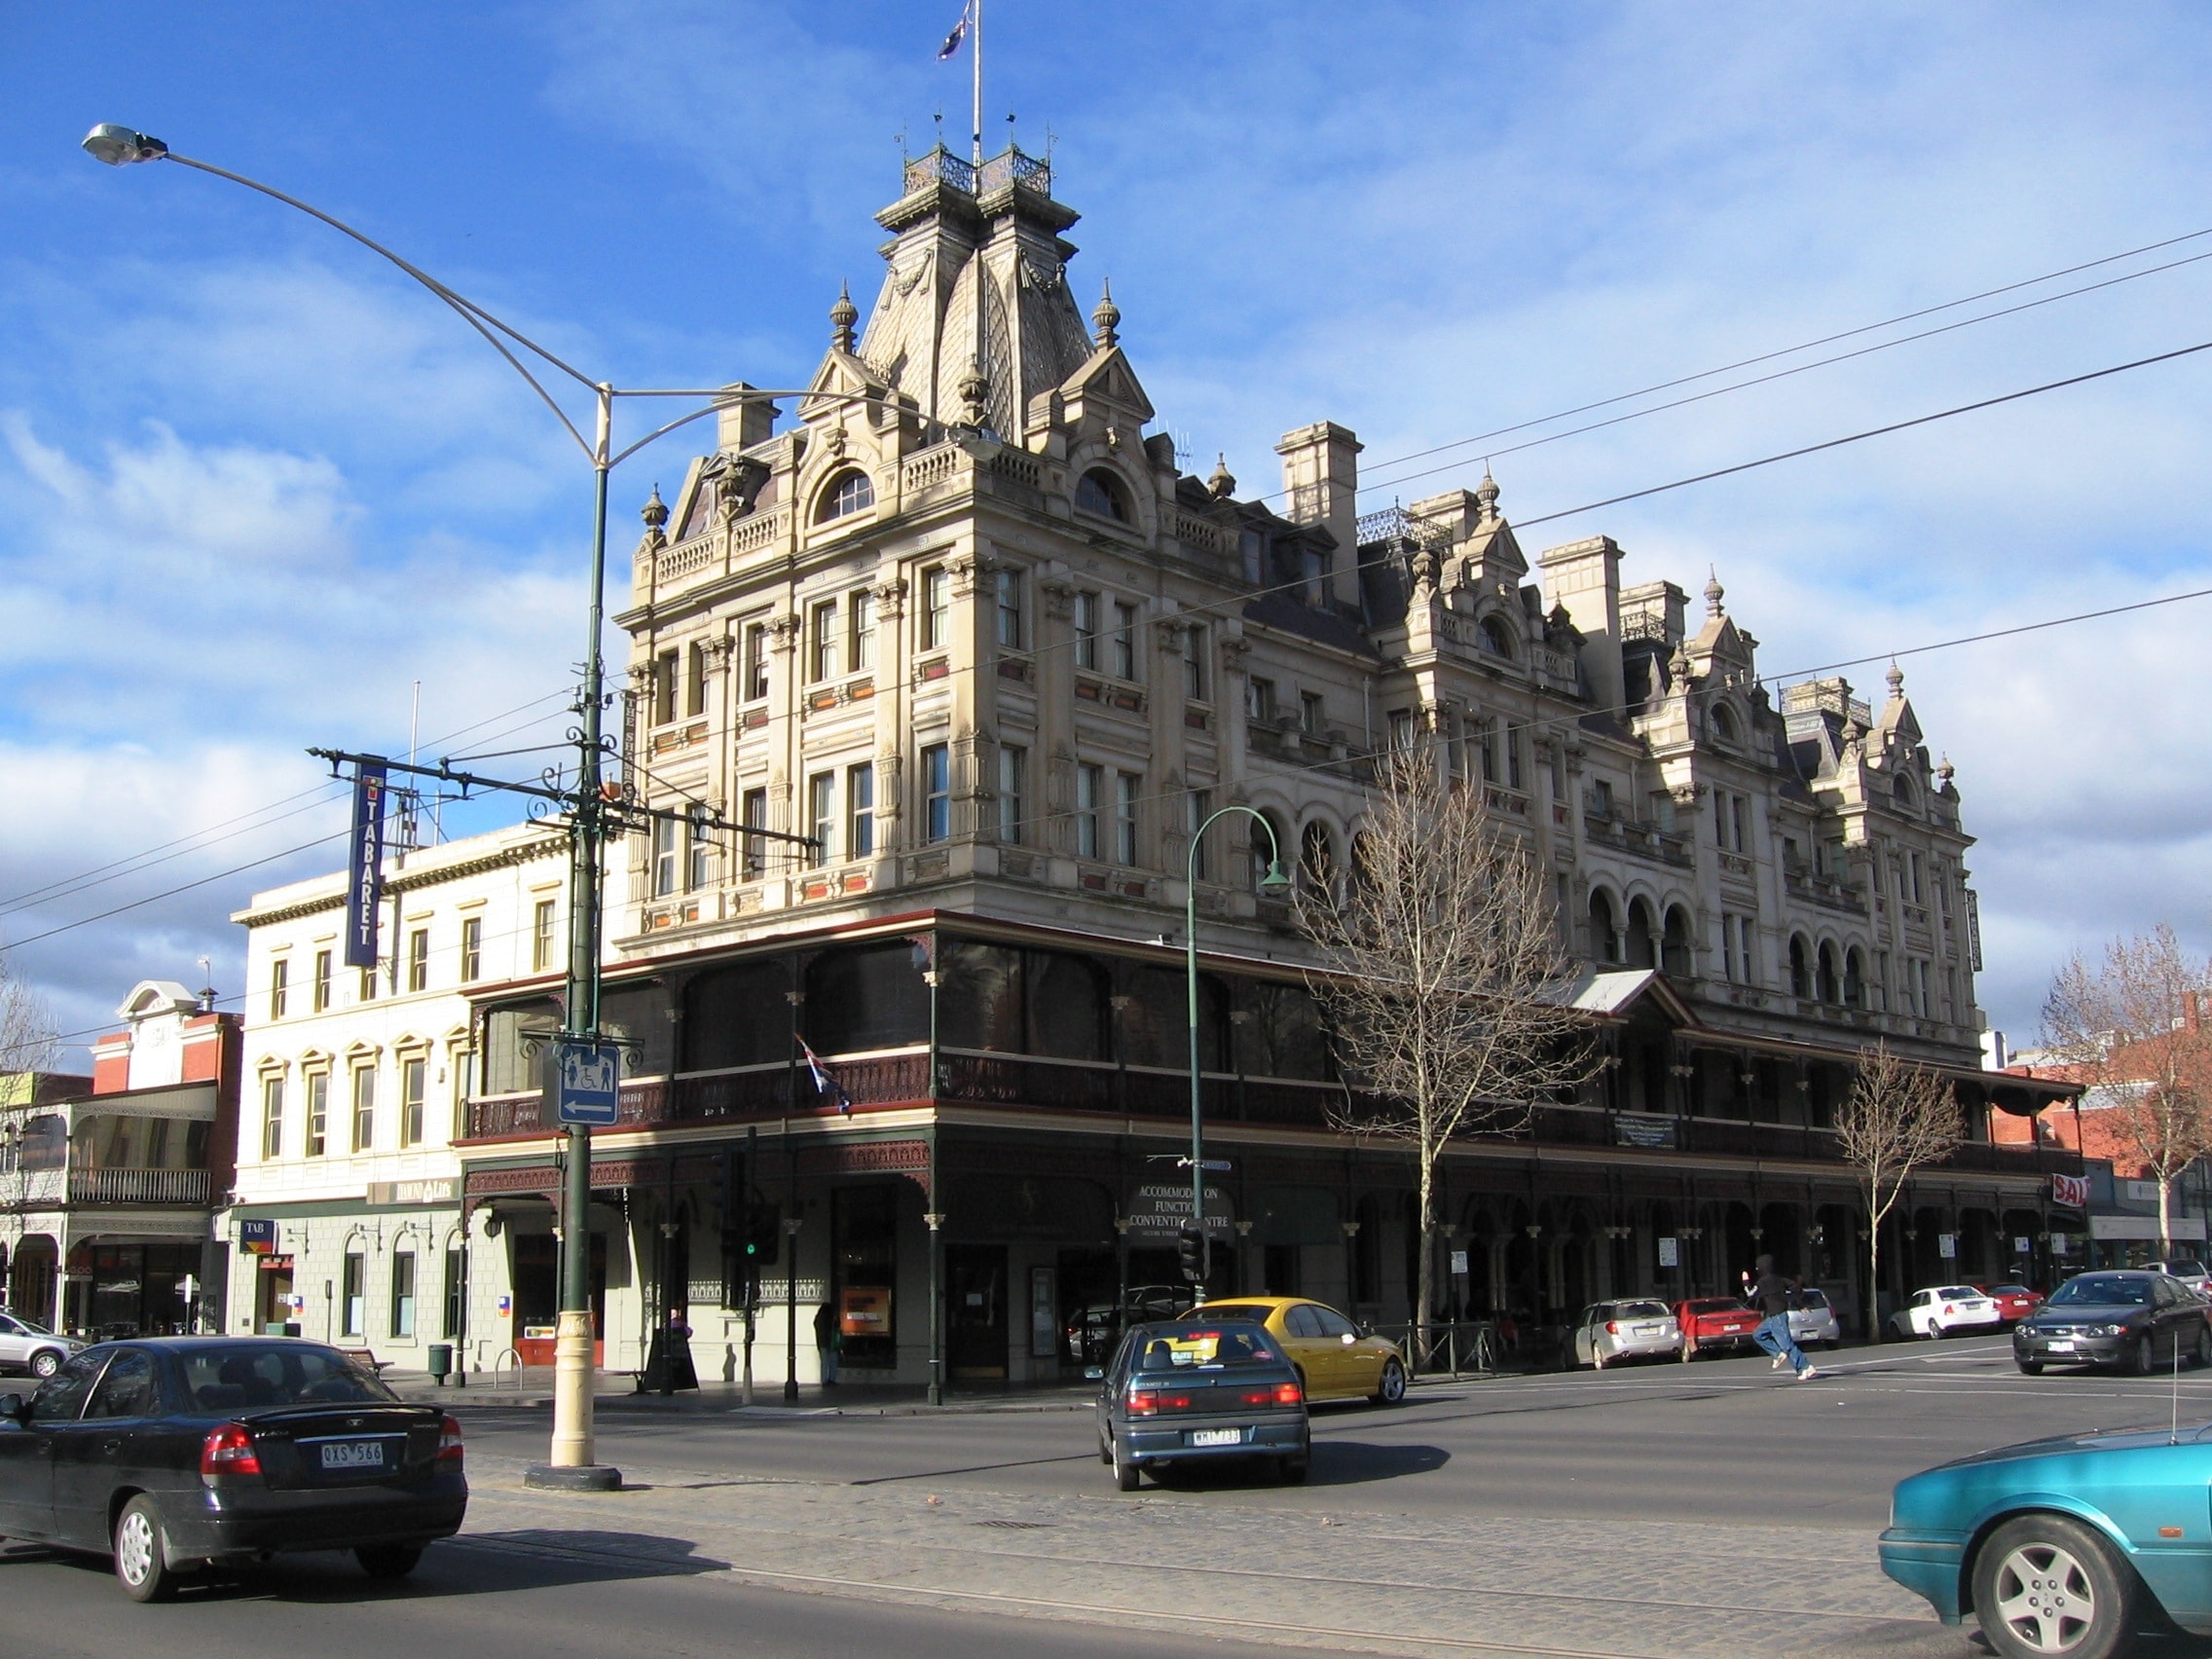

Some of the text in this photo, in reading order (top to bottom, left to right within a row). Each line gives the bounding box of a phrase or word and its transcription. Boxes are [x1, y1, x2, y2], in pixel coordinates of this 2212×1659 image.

[359, 801, 377, 944] TABARET
[1139, 1187, 1218, 1198] ACCOMMODON
[1156, 1201, 1195, 1212] FUNCTIO
[1130, 1215, 1187, 1226] CONVENTI
[245, 1222, 265, 1234] TAB
